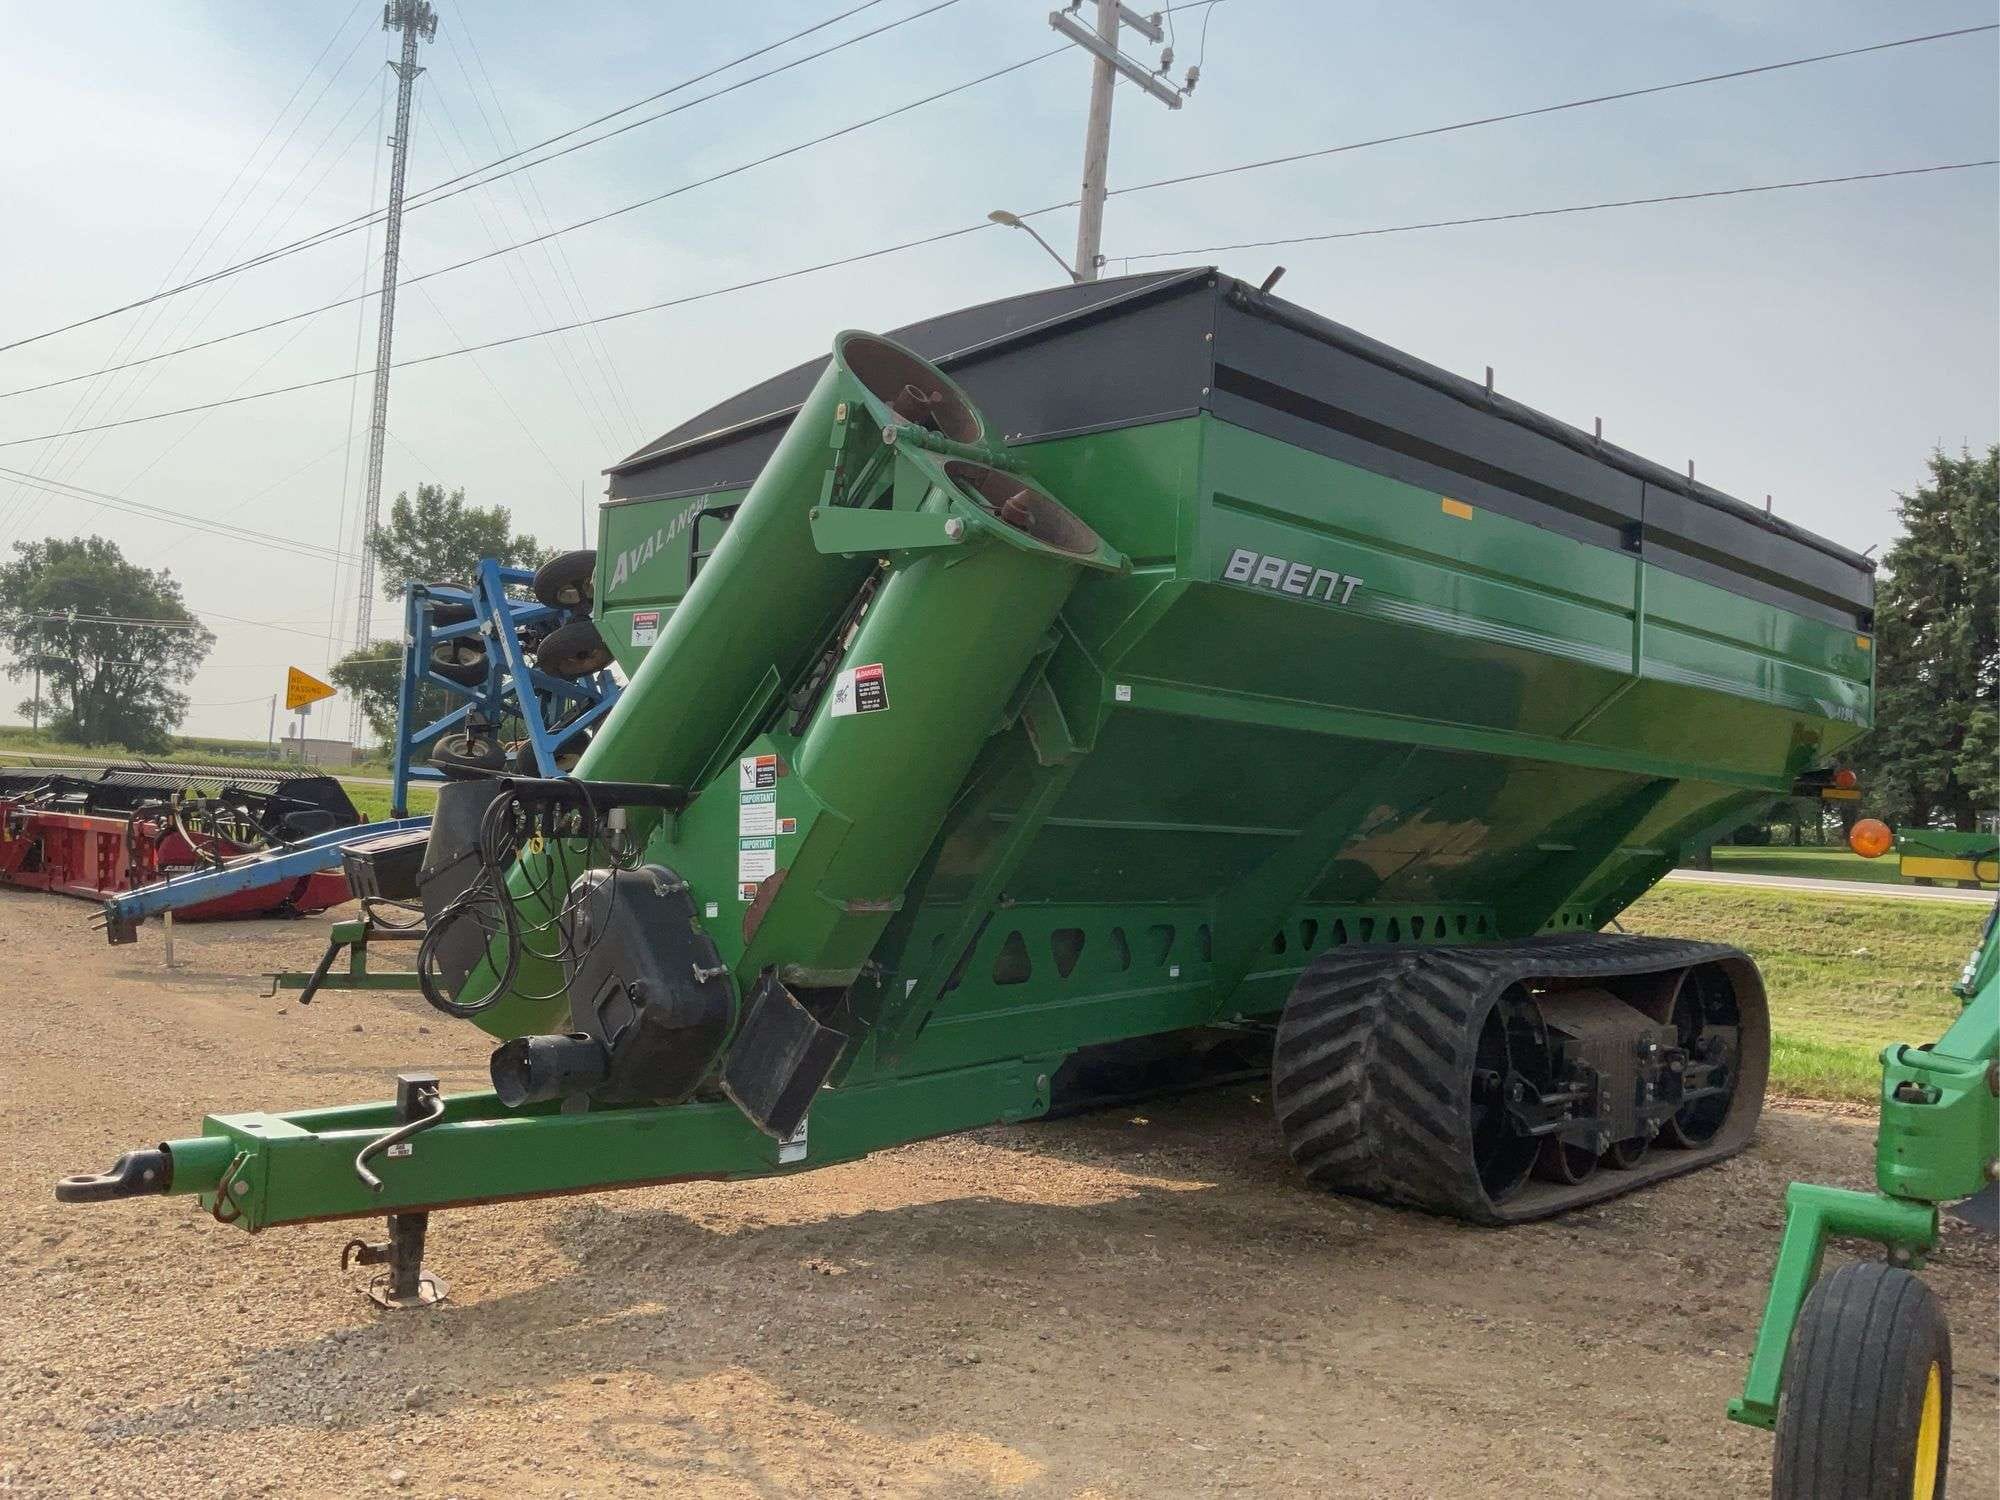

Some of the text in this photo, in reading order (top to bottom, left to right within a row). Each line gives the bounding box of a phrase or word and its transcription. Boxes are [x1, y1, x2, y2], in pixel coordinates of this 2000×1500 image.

[1224, 548, 1364, 604] BRENT
[861, 668, 882, 677] DANGER
[741, 792, 775, 805] IMPORTANT
[741, 838, 773, 850] IMPORTANT
